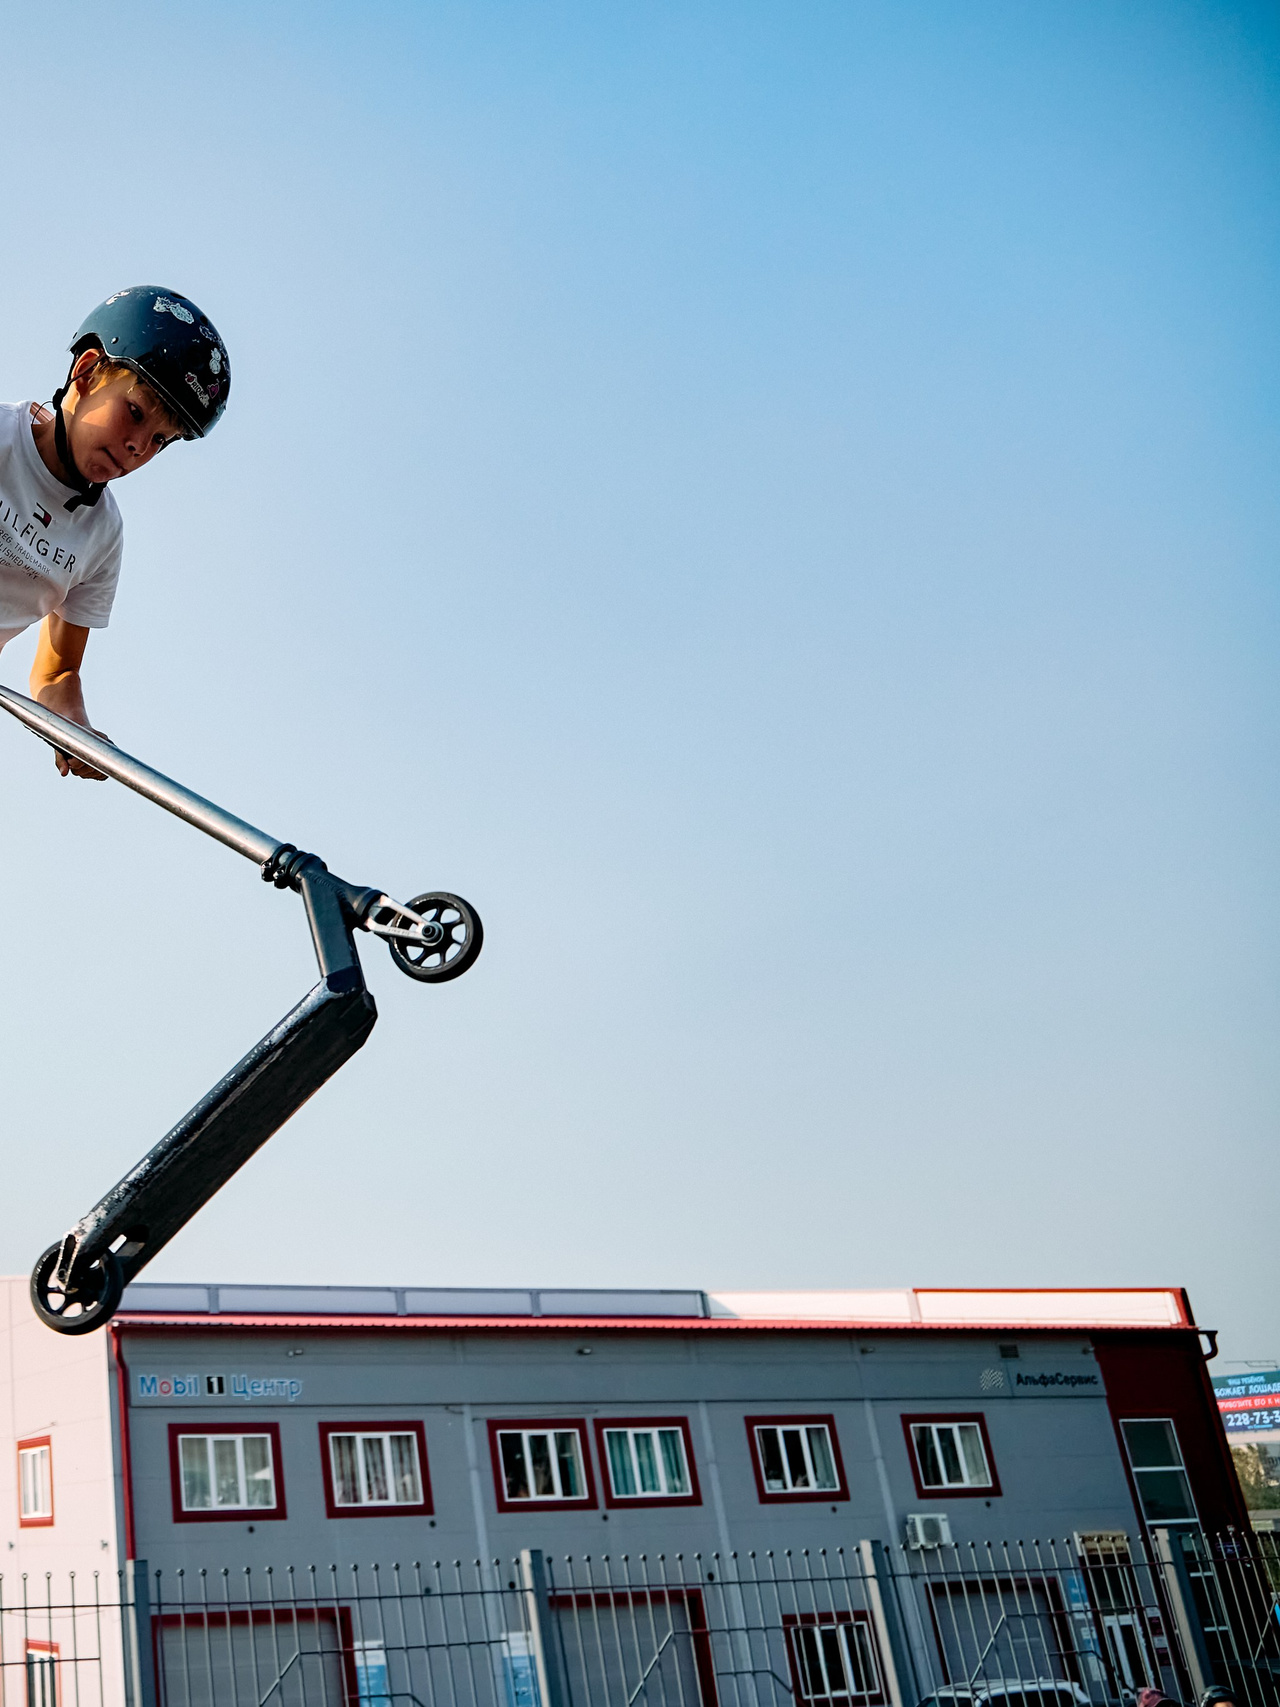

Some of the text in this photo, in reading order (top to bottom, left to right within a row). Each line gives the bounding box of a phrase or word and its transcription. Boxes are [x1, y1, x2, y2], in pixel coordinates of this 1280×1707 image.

[14, 542, 52, 575] TRADEMARK
[139, 1374, 303, 1402] Mobil 1 Центр
[1017, 1373, 1098, 1387] АльфаСервис
